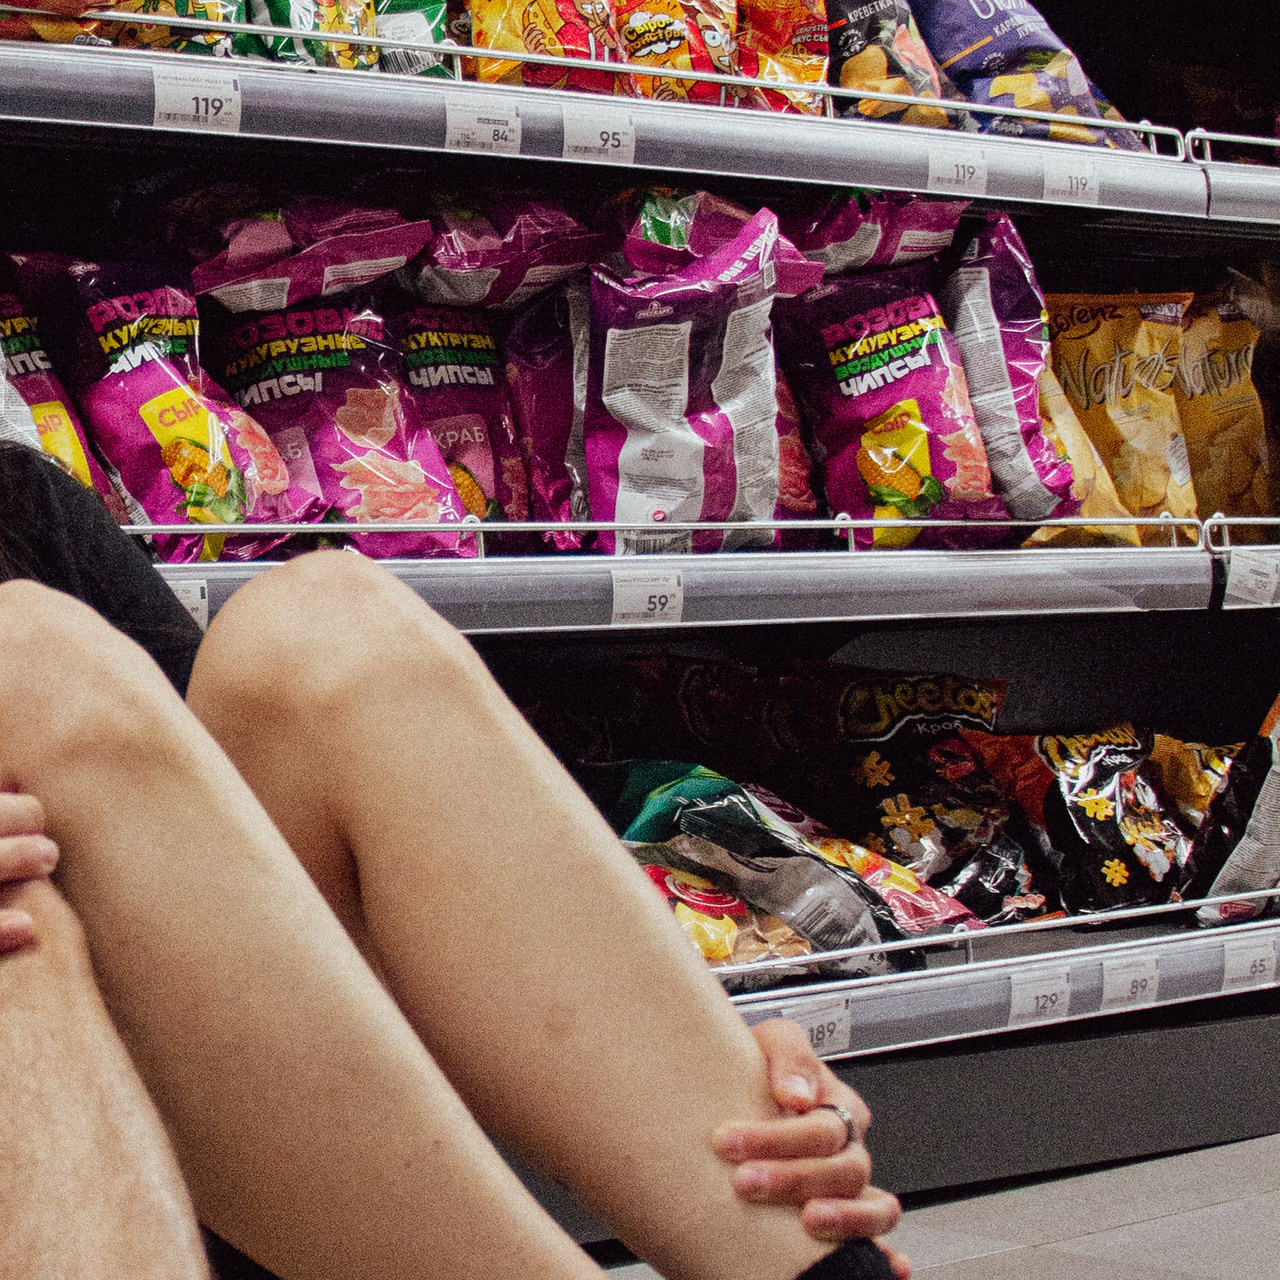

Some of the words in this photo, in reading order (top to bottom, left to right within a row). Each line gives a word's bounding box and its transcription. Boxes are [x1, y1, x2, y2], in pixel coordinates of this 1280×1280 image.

[192, 96, 224, 117] 119
[492, 129, 508, 143] 84
[599, 130, 621, 148] 95
[954, 163, 976, 181] 119
[1067, 175, 1088, 192] 119
[840, 351, 931, 398] ЧИПСЫ
[434, 426, 487, 451] КРАБ
[647, 594, 669, 612] 59
[1249, 958, 1267, 975] 65
[1129, 977, 1149, 995] 89
[1034, 992, 1060, 1010] 129
[807, 1022, 837, 1045] 189
